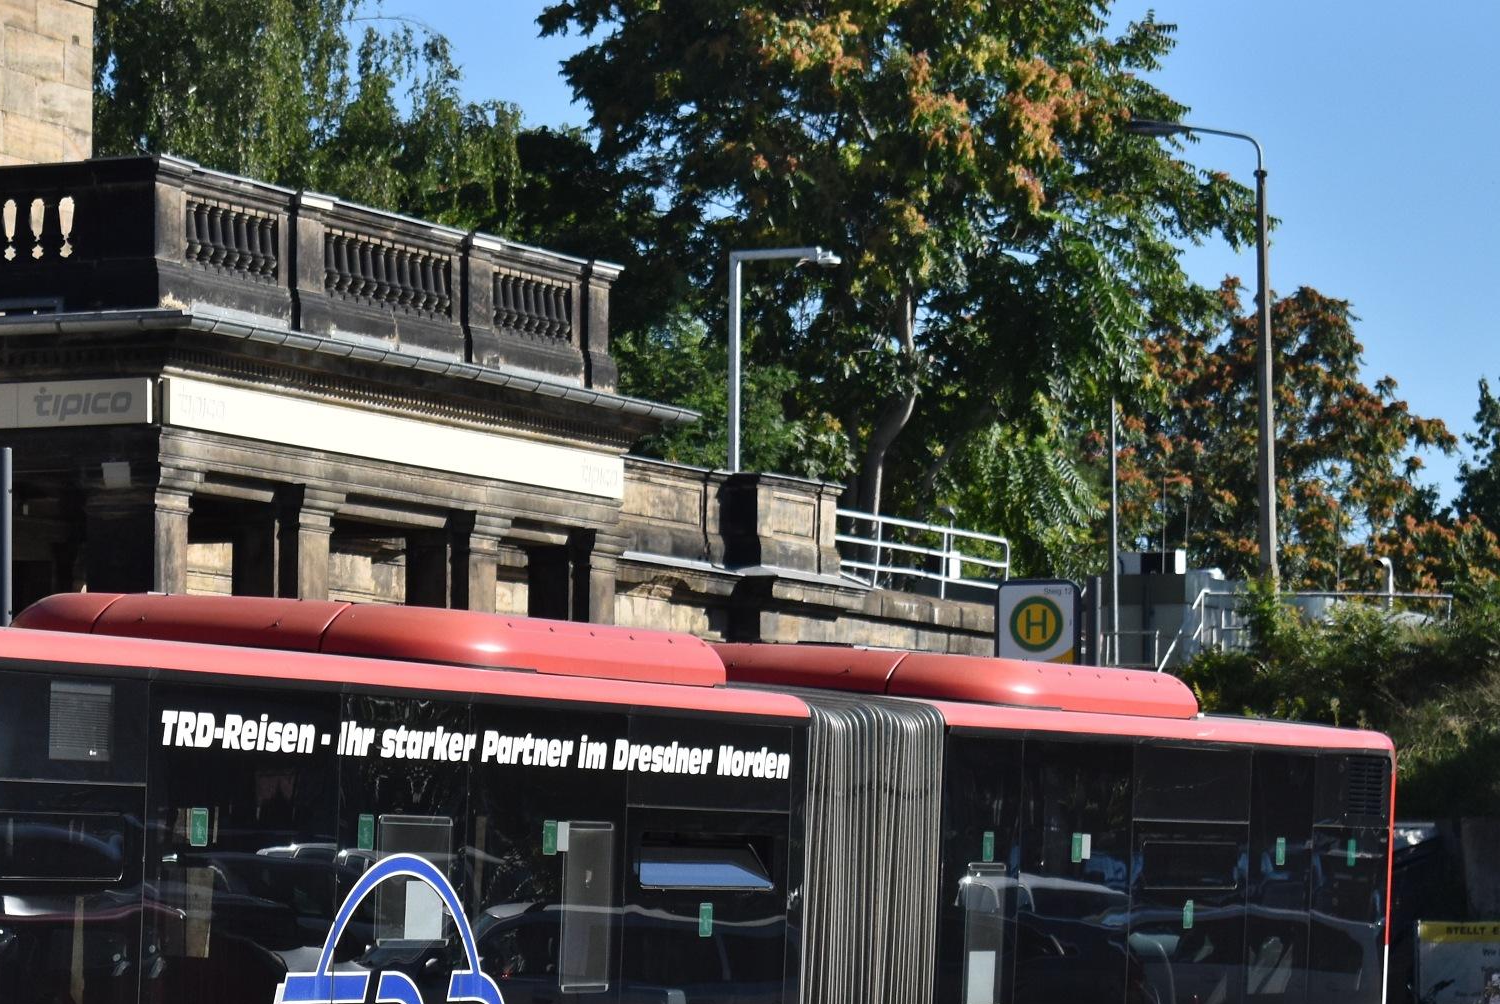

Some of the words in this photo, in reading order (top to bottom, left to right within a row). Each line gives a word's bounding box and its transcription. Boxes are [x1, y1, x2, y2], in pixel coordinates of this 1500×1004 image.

[33, 386, 133, 421] tipico
[1025, 609, 1047, 640] H
[161, 710, 315, 754] TRD-Reisen
[337, 721, 375, 757] Ihr
[381, 725, 477, 762] starker
[481, 731, 574, 768] Partner
[577, 734, 608, 770] im
[613, 738, 713, 775] Dresdner
[717, 745, 791, 780] Norden
